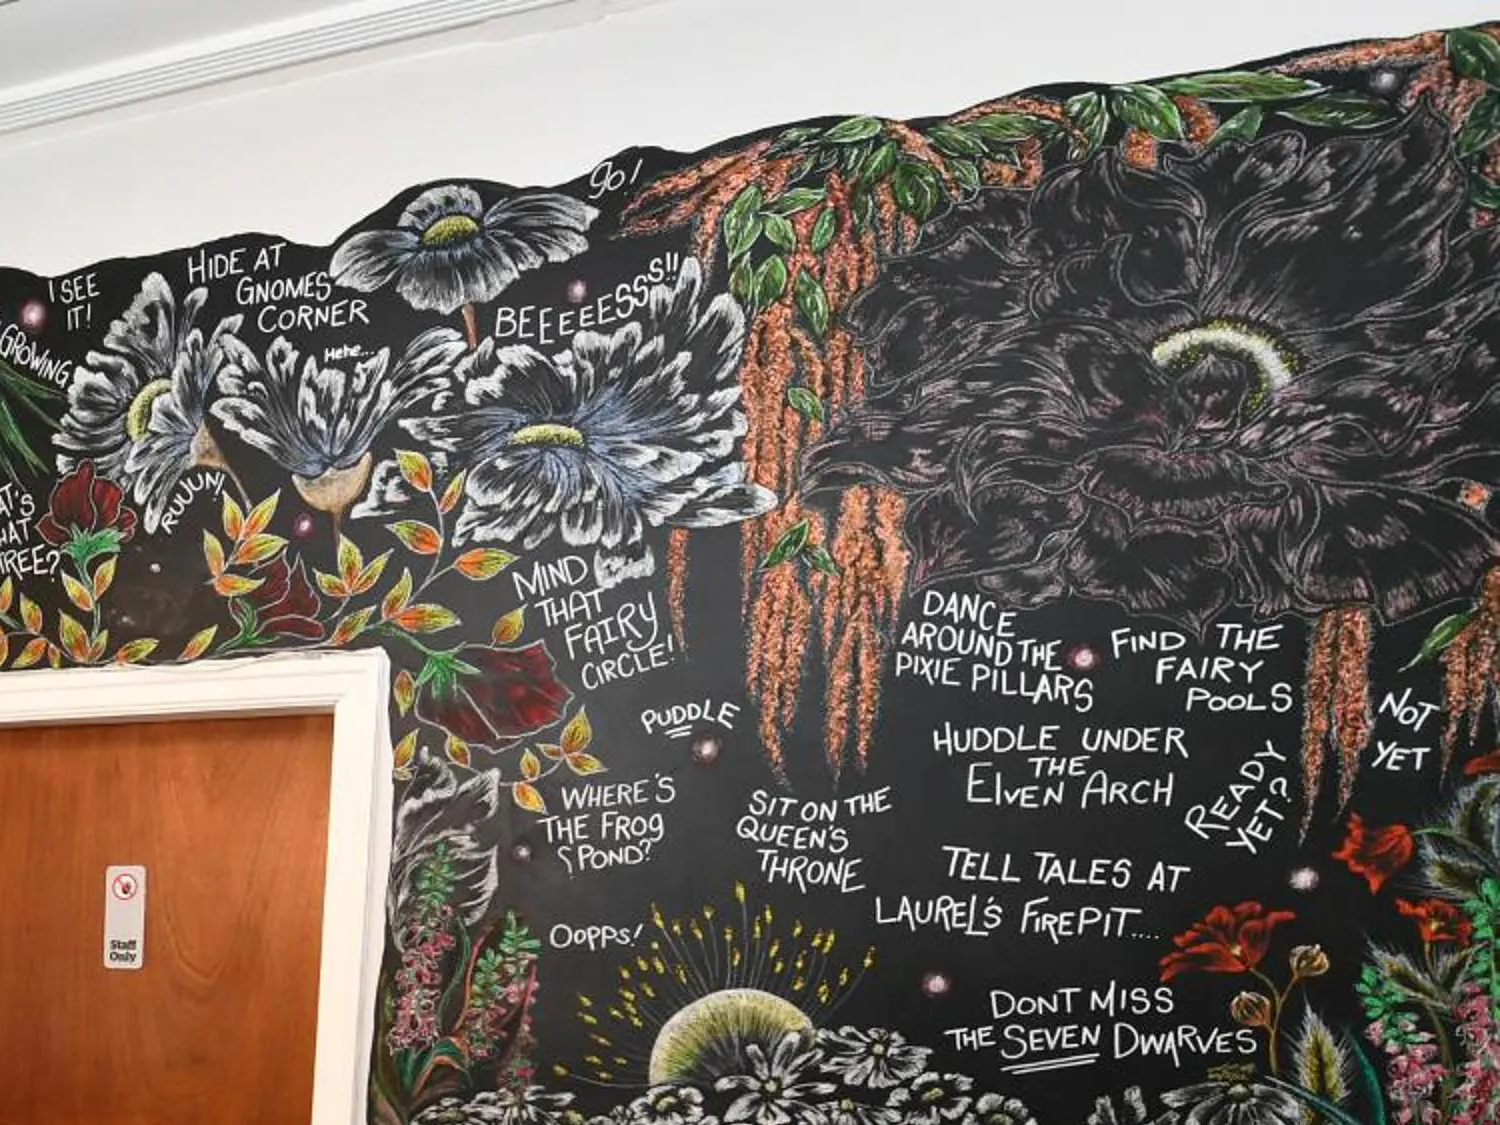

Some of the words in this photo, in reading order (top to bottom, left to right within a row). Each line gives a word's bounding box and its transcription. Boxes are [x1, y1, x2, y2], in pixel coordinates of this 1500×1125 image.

[187, 248, 247, 284] HIDE
[253, 242, 287, 271] AT
[48, 279, 56, 304] I
[60, 272, 100, 300] SEE
[236, 272, 332, 305] GNOMES
[67, 303, 92, 331] IT!
[257, 299, 370, 333] CORNER
[161, 471, 226, 535] RUUUN!
[512, 555, 589, 601] MIND
[534, 586, 605, 627] THAT
[564, 591, 659, 660] FAIRY
[923, 590, 1018, 638] DANCE
[581, 633, 675, 690] CIRCLE!
[901, 621, 1013, 667] AROUND
[1017, 639, 1063, 671] THE
[1111, 627, 1187, 660] FIND
[1216, 623, 1284, 653] THE
[895, 651, 962, 686] PIXIE
[972, 663, 1094, 713] PILLARS
[1155, 656, 1265, 685] FAIRY
[641, 698, 741, 736] PUDDLE
[1186, 681, 1294, 713] POOLS
[1378, 687, 1440, 732] NOT
[933, 721, 1061, 757] HUDDLE
[1081, 726, 1189, 759] UNDER
[1371, 740, 1431, 772] YET
[1028, 755, 1092, 778] THE
[561, 773, 676, 811] WHERE'S
[749, 789, 798, 817] SIT
[801, 800, 837, 822] ON
[844, 786, 893, 817] THE
[1081, 769, 1175, 810] ARCH
[1184, 739, 1288, 841] READY
[536, 814, 591, 845] THE
[736, 815, 850, 853] QUEEN'S
[1226, 776, 1293, 855] YET?
[757, 849, 866, 895] THRONE
[942, 845, 1021, 883] TELL
[1033, 851, 1133, 888] TALES
[1147, 861, 1192, 893] AT
[875, 894, 1003, 937] LAUREL'S
[109, 939, 137, 951] Staff
[109, 951, 137, 963] Only
[989, 987, 1082, 1020] DONT
[1089, 979, 1175, 1017] MISS
[944, 1025, 996, 1052] THE
[1001, 1023, 1101, 1060] SEVEN
[1113, 1022, 1258, 1068] DWARVES
